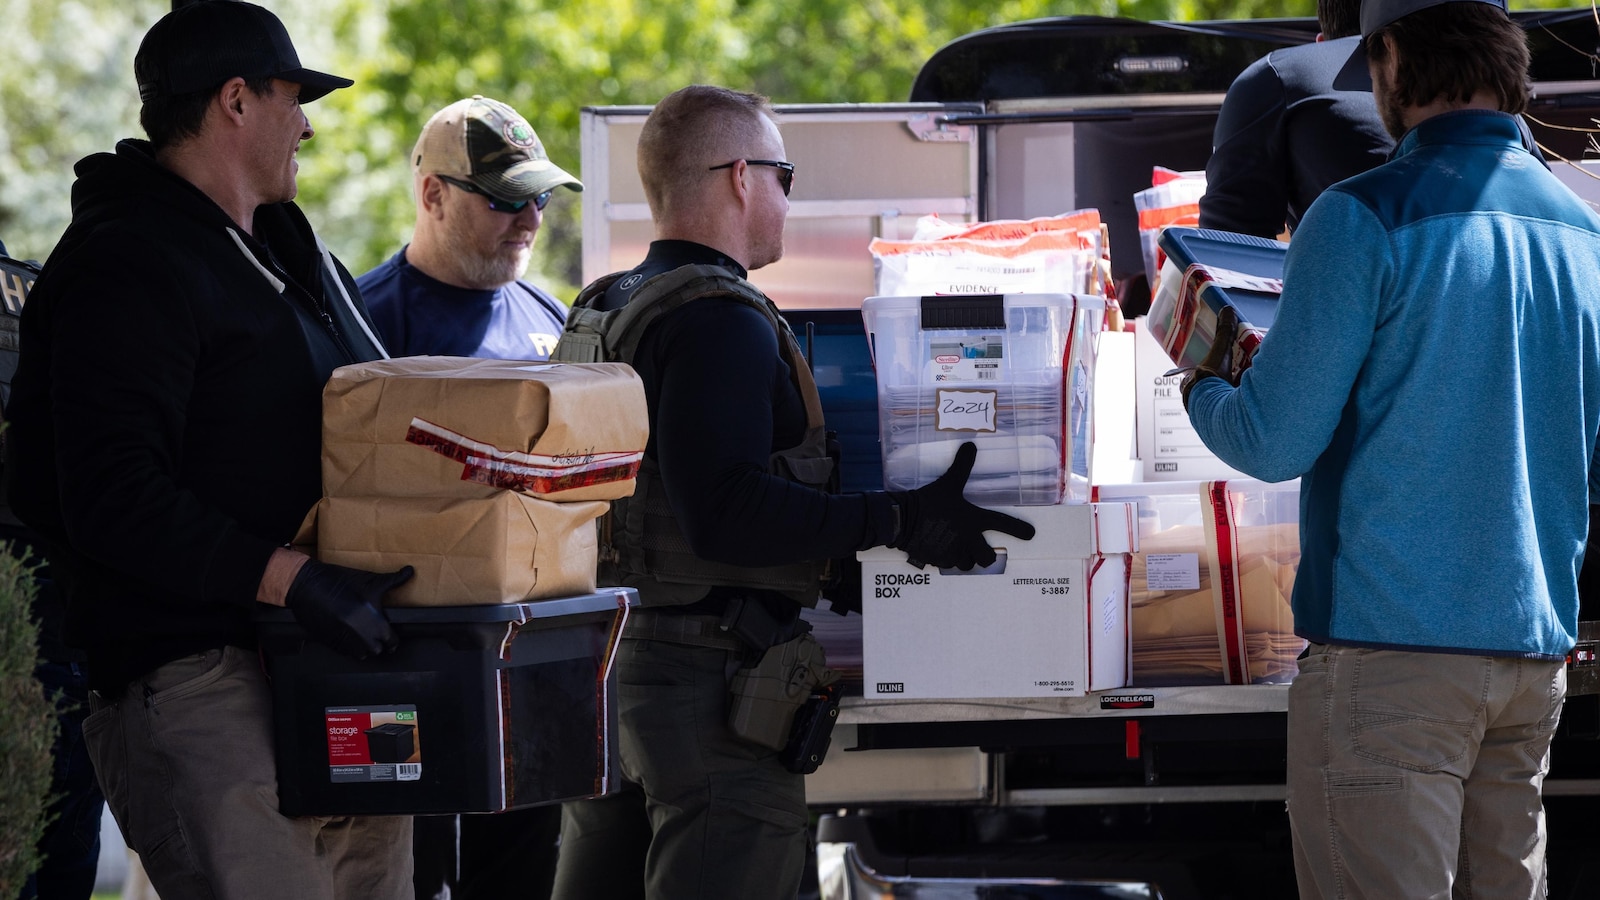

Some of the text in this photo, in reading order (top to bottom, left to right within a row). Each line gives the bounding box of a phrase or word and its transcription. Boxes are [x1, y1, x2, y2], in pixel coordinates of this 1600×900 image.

[0, 269, 35, 312] H
[949, 284, 999, 294] EVIDENCE
[1154, 388, 1171, 397] FILE
[943, 399, 989, 423] 2024
[1156, 463, 1177, 471] ULINE
[875, 574, 930, 586] STORAGE
[1013, 577, 1070, 586] LETTER/LEGAL SIZE
[875, 587, 901, 599] BOX
[1041, 587, 1070, 595] S-3887
[1221, 563, 1236, 618] EVIDENCE
[878, 684, 904, 692] ULINE
[329, 727, 358, 736] storage
